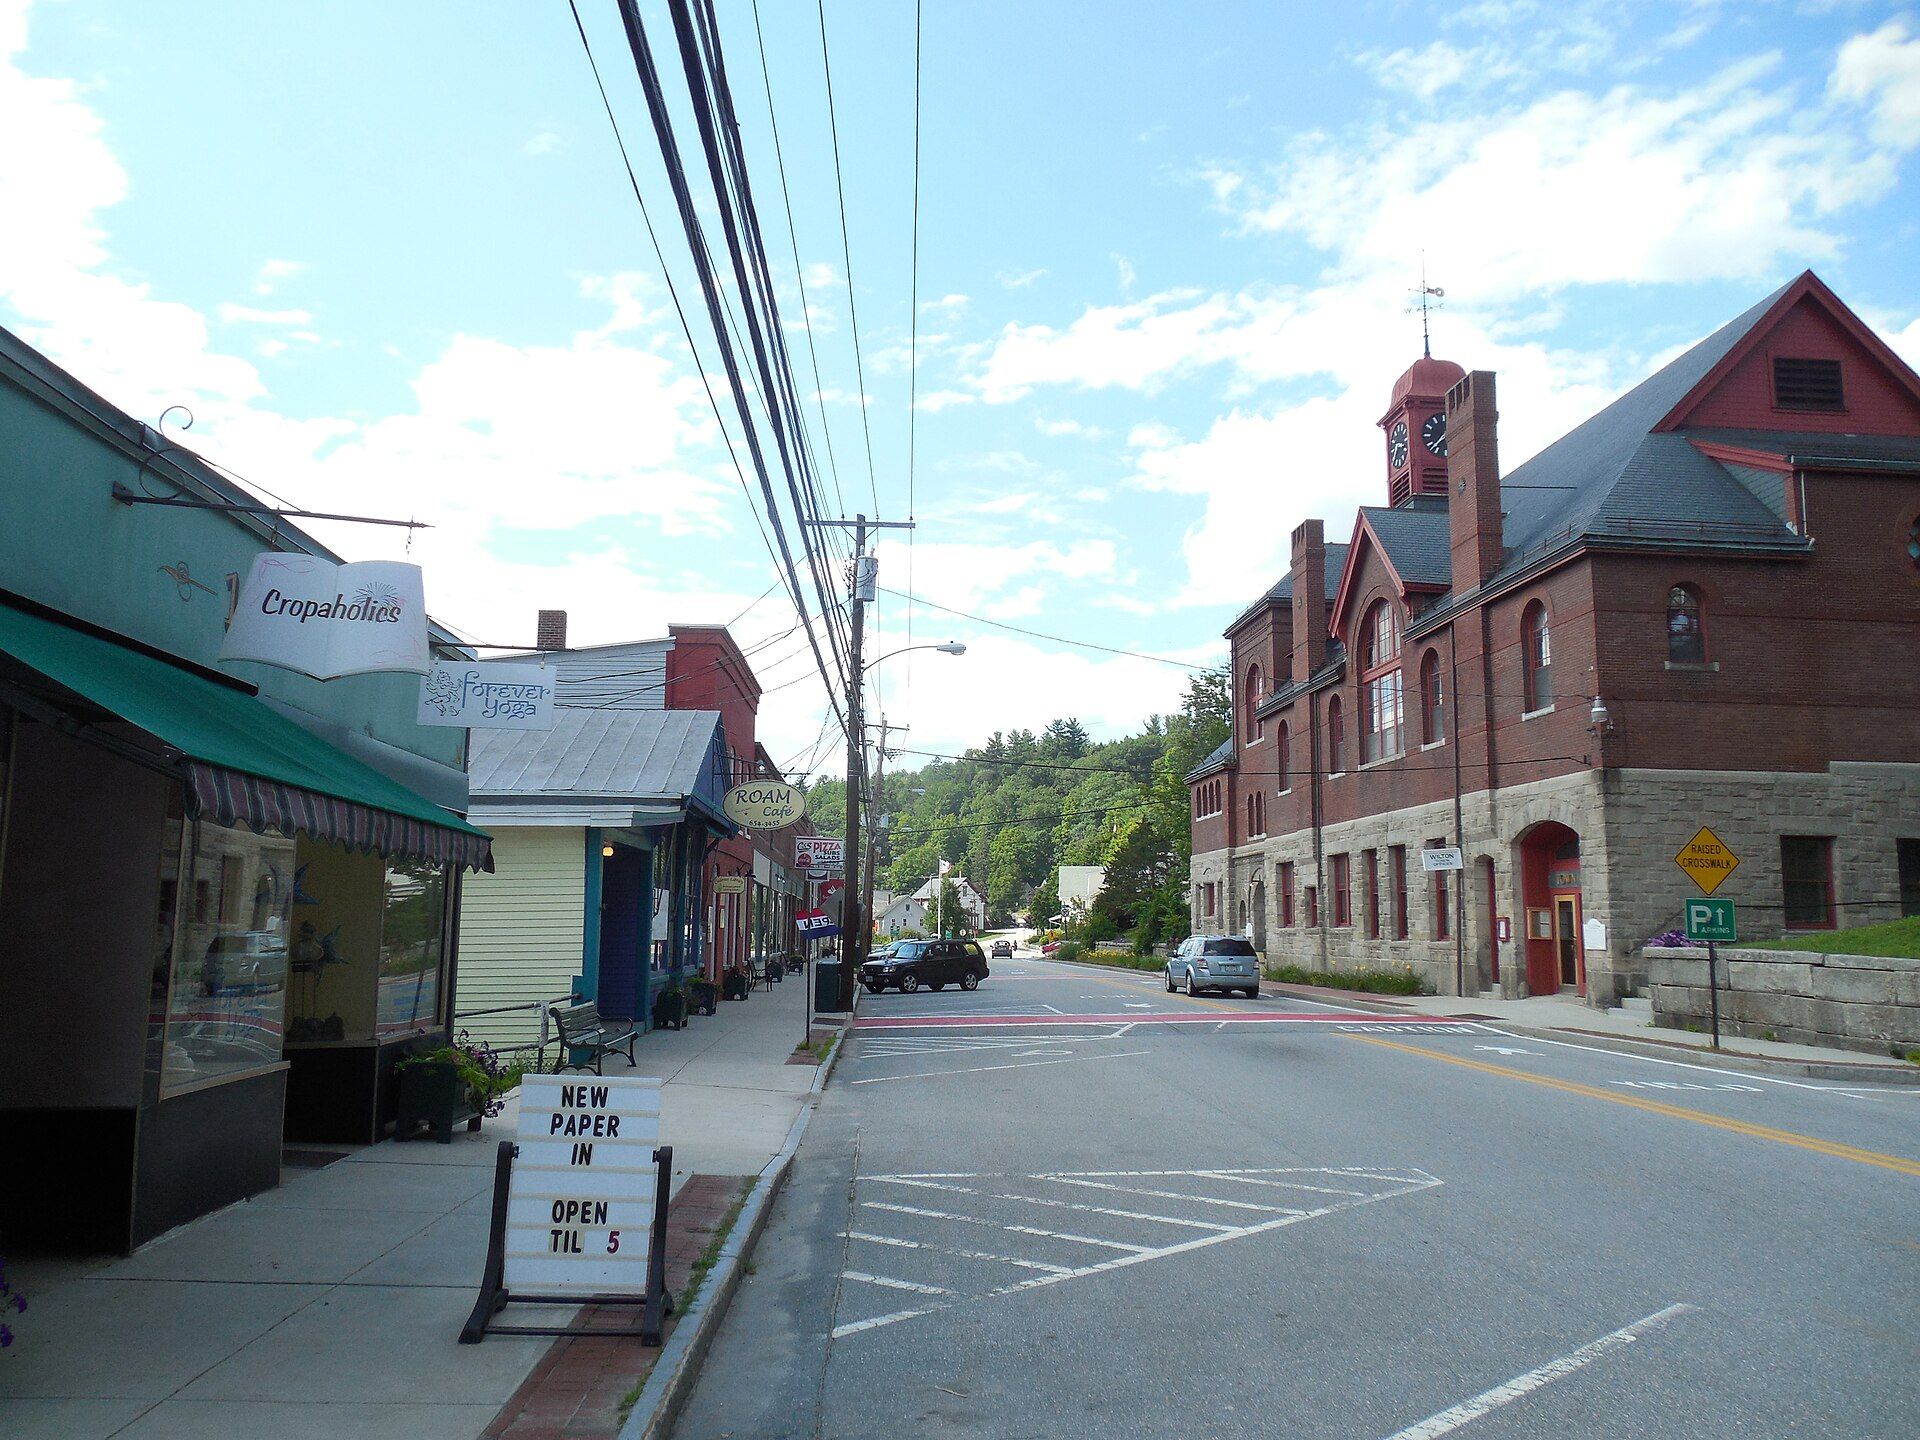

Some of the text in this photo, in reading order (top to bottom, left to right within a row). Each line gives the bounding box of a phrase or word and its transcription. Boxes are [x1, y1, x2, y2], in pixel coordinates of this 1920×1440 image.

[261, 588, 402, 624] Cropaholics
[461, 670, 551, 709] forever
[482, 697, 536, 721] yoga
[734, 788, 791, 805] ROAM
[762, 804, 795, 819] Café
[812, 841, 842, 854] PIZZA
[1691, 844, 1722, 855] RAISED
[1682, 857, 1732, 870] CROSSWALK
[561, 1085, 609, 1108] NEW
[550, 1113, 620, 1138] PAPER
[571, 1142, 593, 1166] IN
[552, 1199, 608, 1225] OPEN
[551, 1229, 620, 1254] TIL 5
